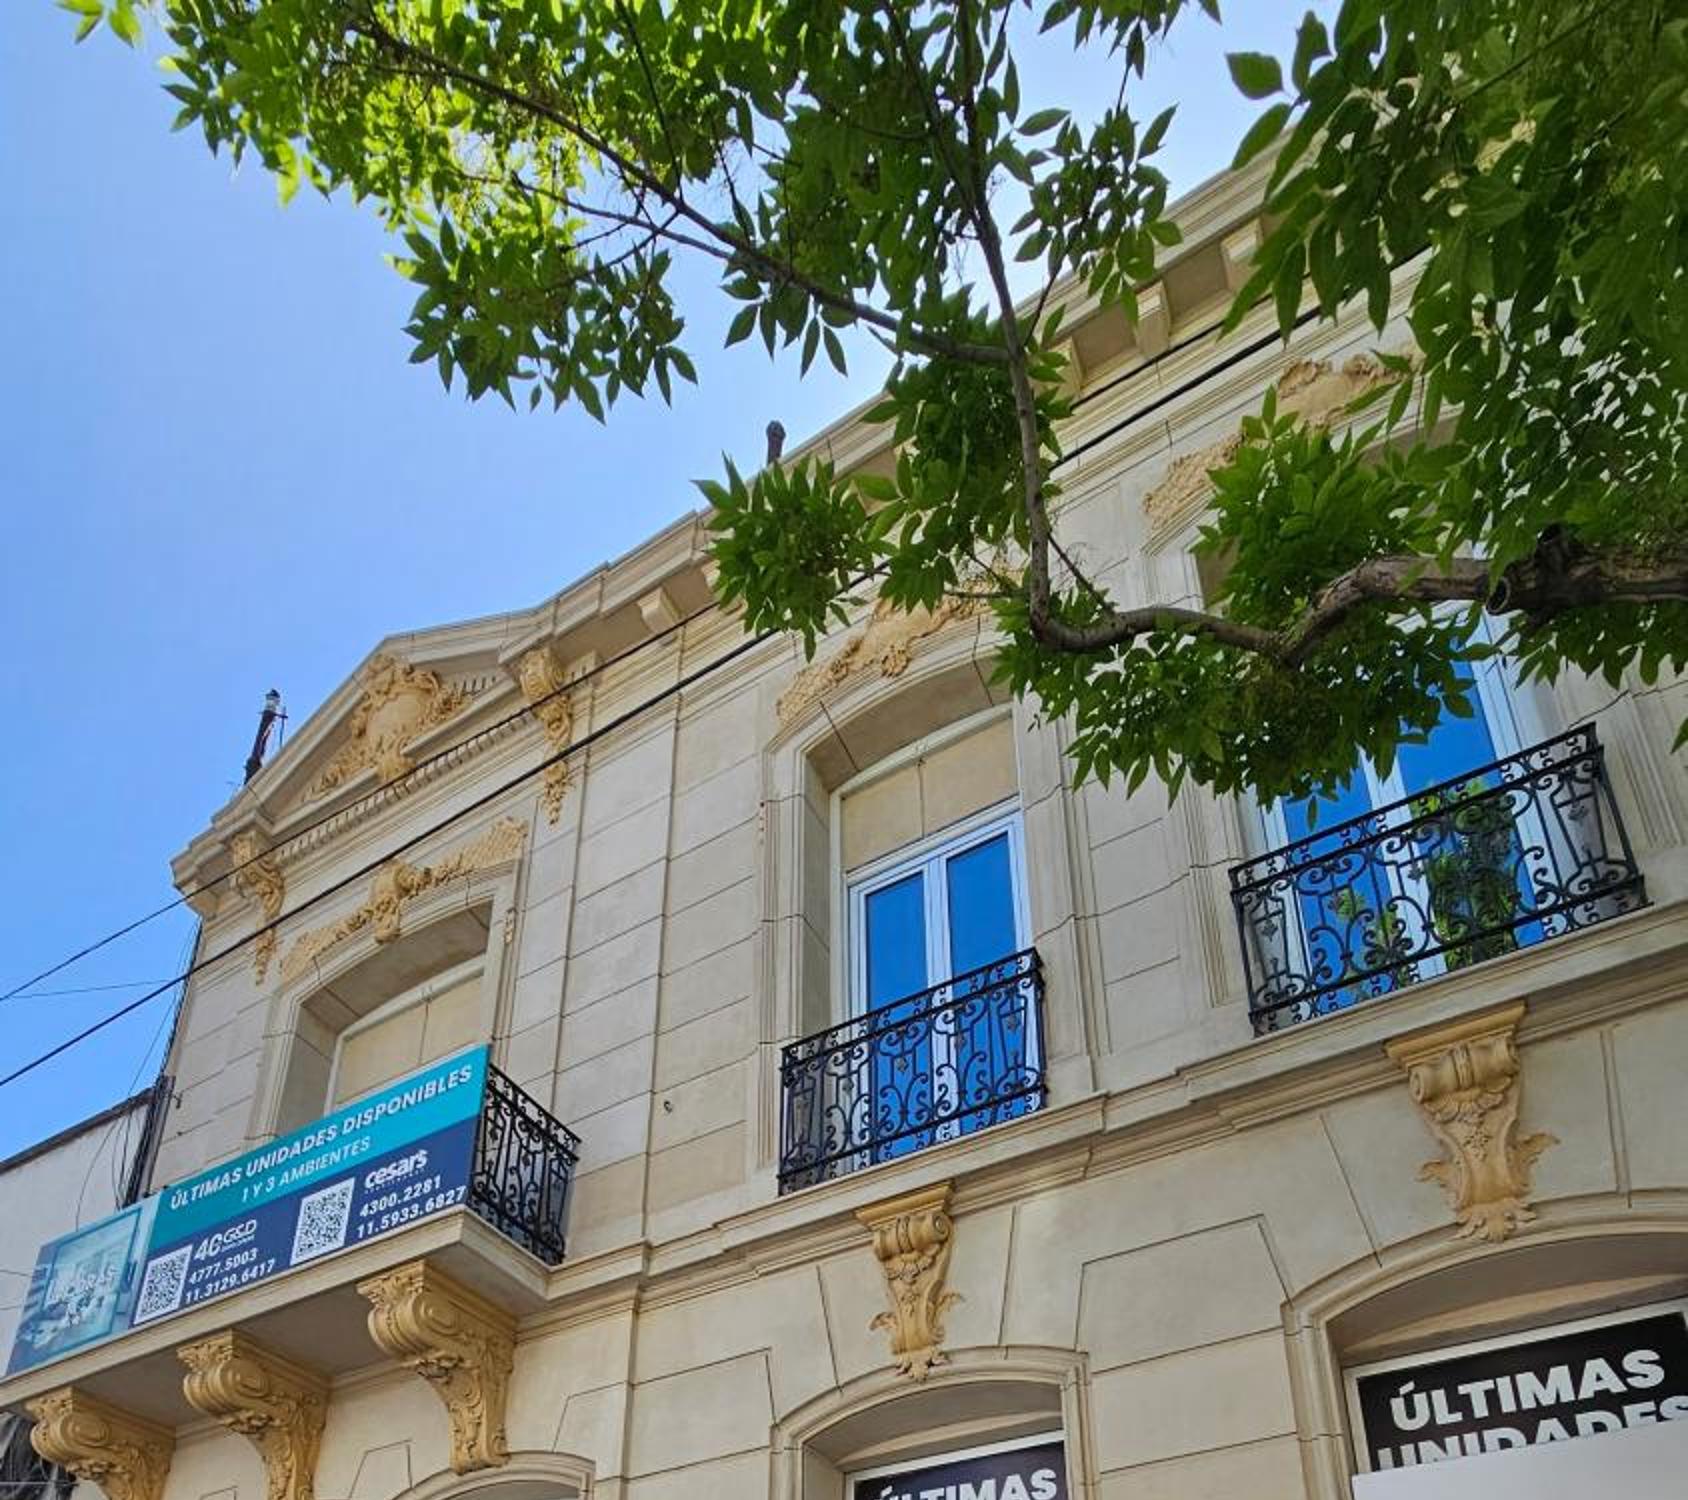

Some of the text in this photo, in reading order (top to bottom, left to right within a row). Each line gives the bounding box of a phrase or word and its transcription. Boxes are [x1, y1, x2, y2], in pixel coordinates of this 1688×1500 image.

[171, 1064, 472, 1209] ÚLTIMAS UNIDADES DISPONIBLES
[253, 1182, 262, 1197] Y
[266, 1177, 275, 1192] 3
[279, 1136, 370, 1185] AMBIENTES
[1390, 1349, 1665, 1432] ÚLTIMAS
